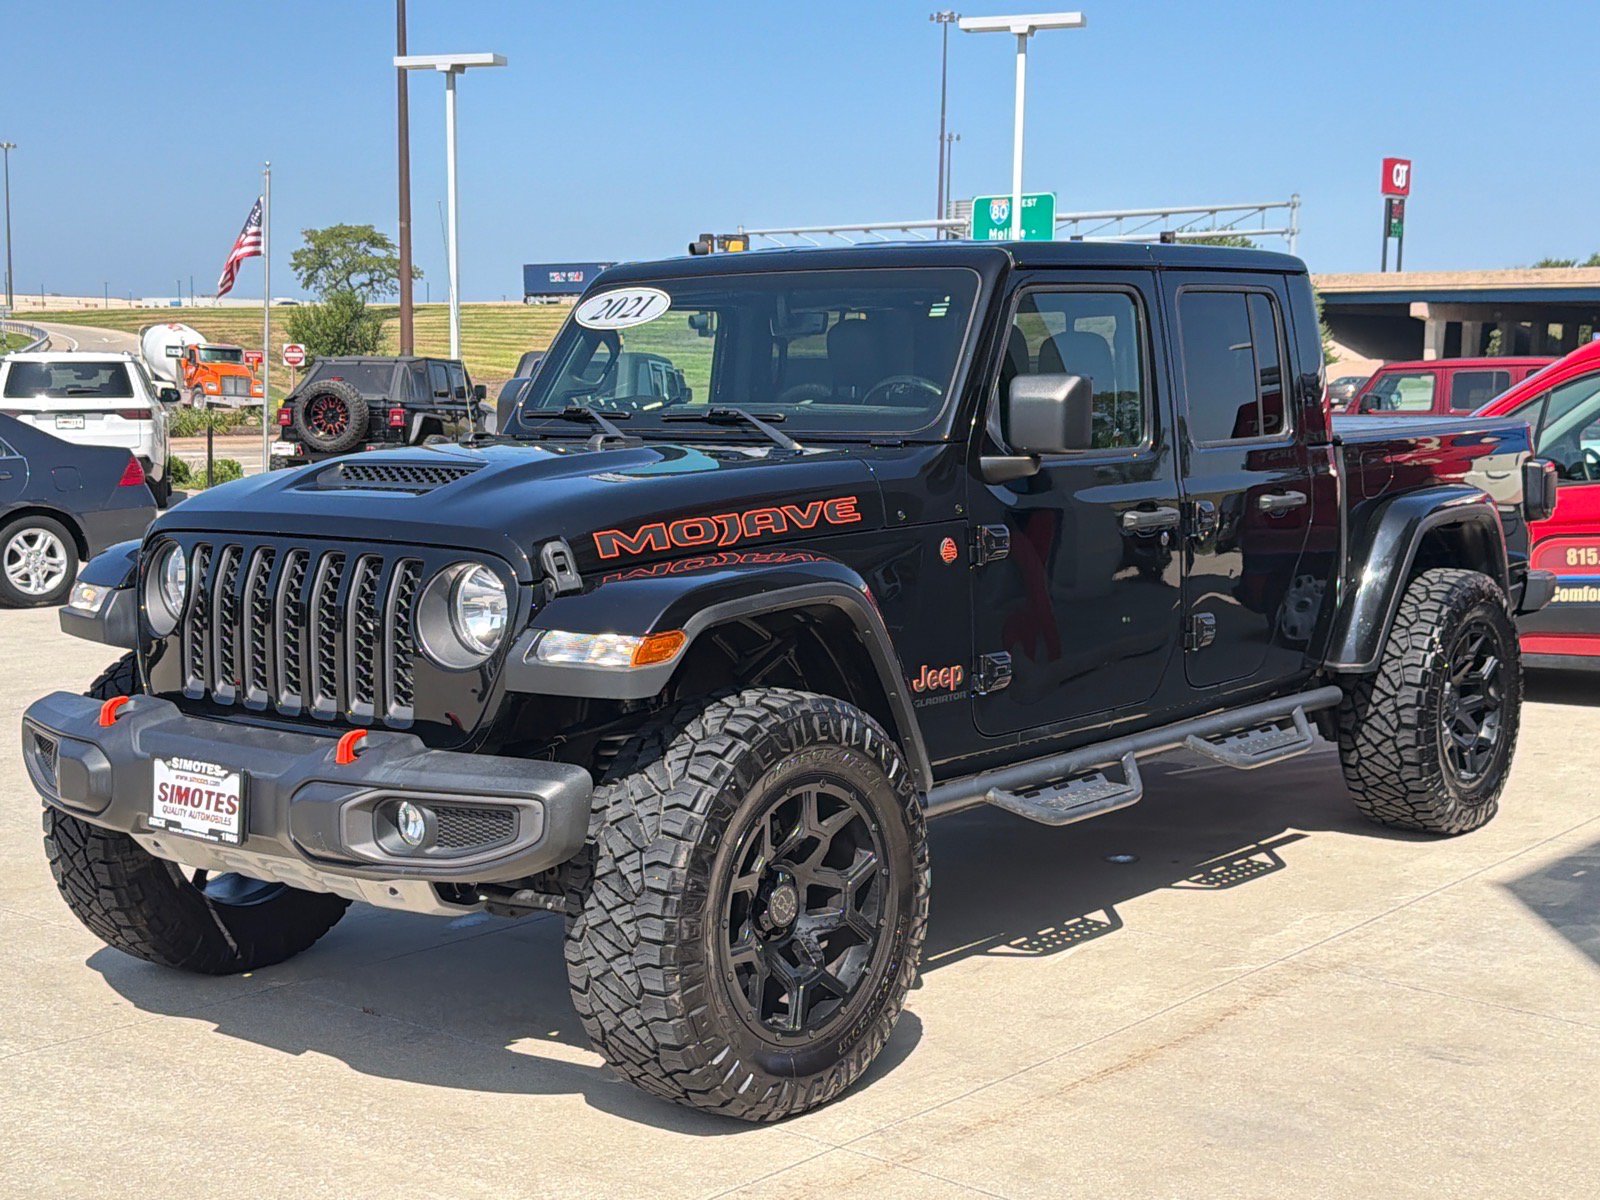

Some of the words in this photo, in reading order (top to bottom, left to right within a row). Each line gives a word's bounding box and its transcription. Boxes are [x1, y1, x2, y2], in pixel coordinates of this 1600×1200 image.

[1392, 163, 1409, 188] QT
[992, 206, 1007, 220] 80
[988, 227, 1026, 240] Molie
[588, 295, 657, 321] 2021
[592, 496, 861, 559] MOJAVE
[912, 664, 964, 693] Jeep
[913, 690, 967, 708] GLADIATOR
[171, 757, 222, 776] SIMOTES
[157, 782, 240, 815] SIMOTES
[162, 804, 187, 818] QUALITY
[188, 809, 232, 826] AUTOMOBILES
